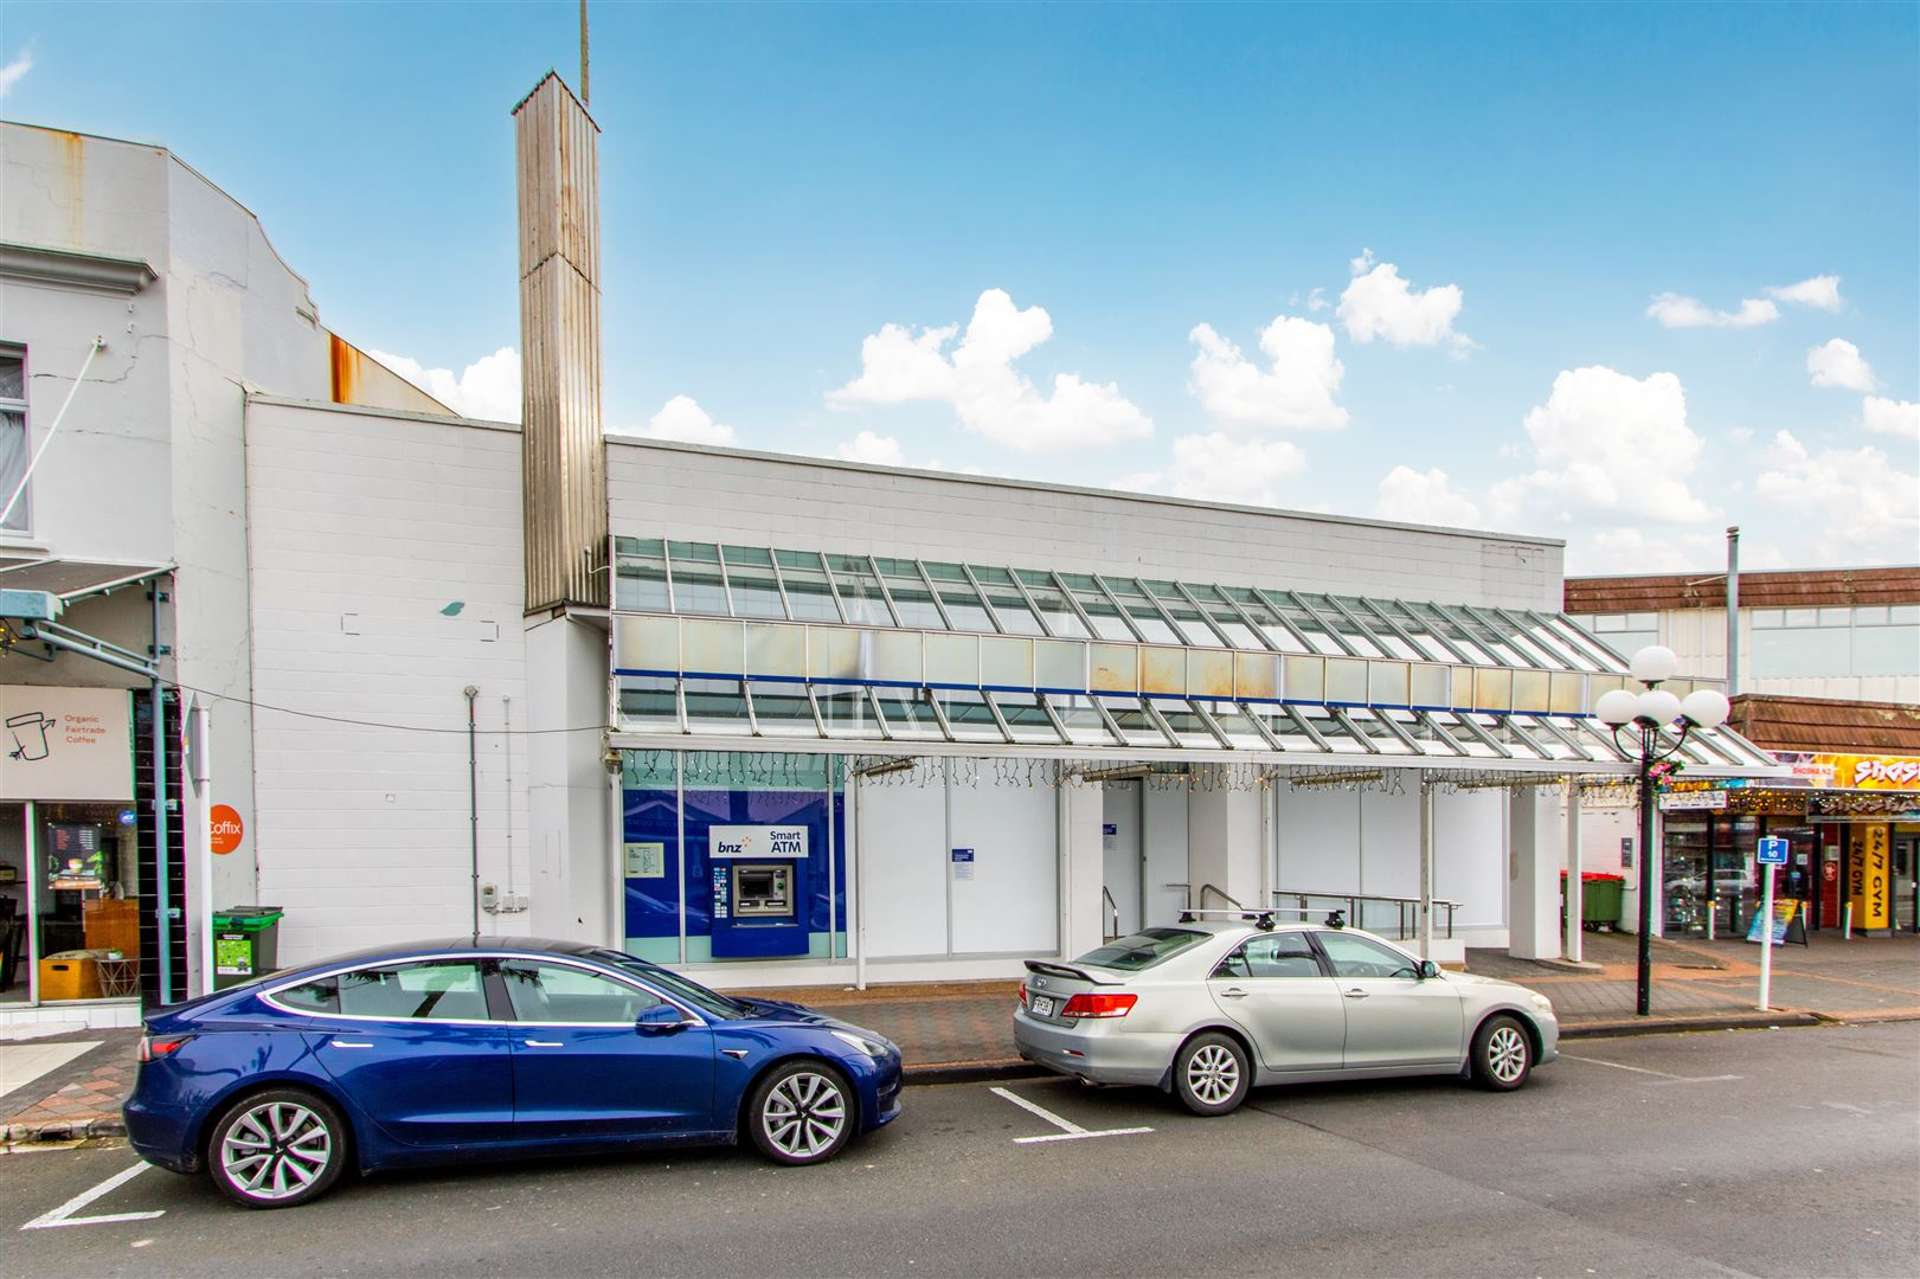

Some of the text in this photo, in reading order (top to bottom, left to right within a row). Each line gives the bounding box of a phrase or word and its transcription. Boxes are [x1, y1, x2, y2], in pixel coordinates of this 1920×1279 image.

[64, 714, 99, 724] Organic
[65, 725, 106, 734] Fairtrade
[66, 735, 97, 744] Coffee
[770, 831, 801, 840] Smart
[718, 842, 742, 853] bnz
[771, 842, 801, 853] ATM
[1768, 840, 1778, 849] P
[1851, 840, 1864, 896] 24/7 GYM
[1872, 828, 1884, 917] 24/7 GYM
